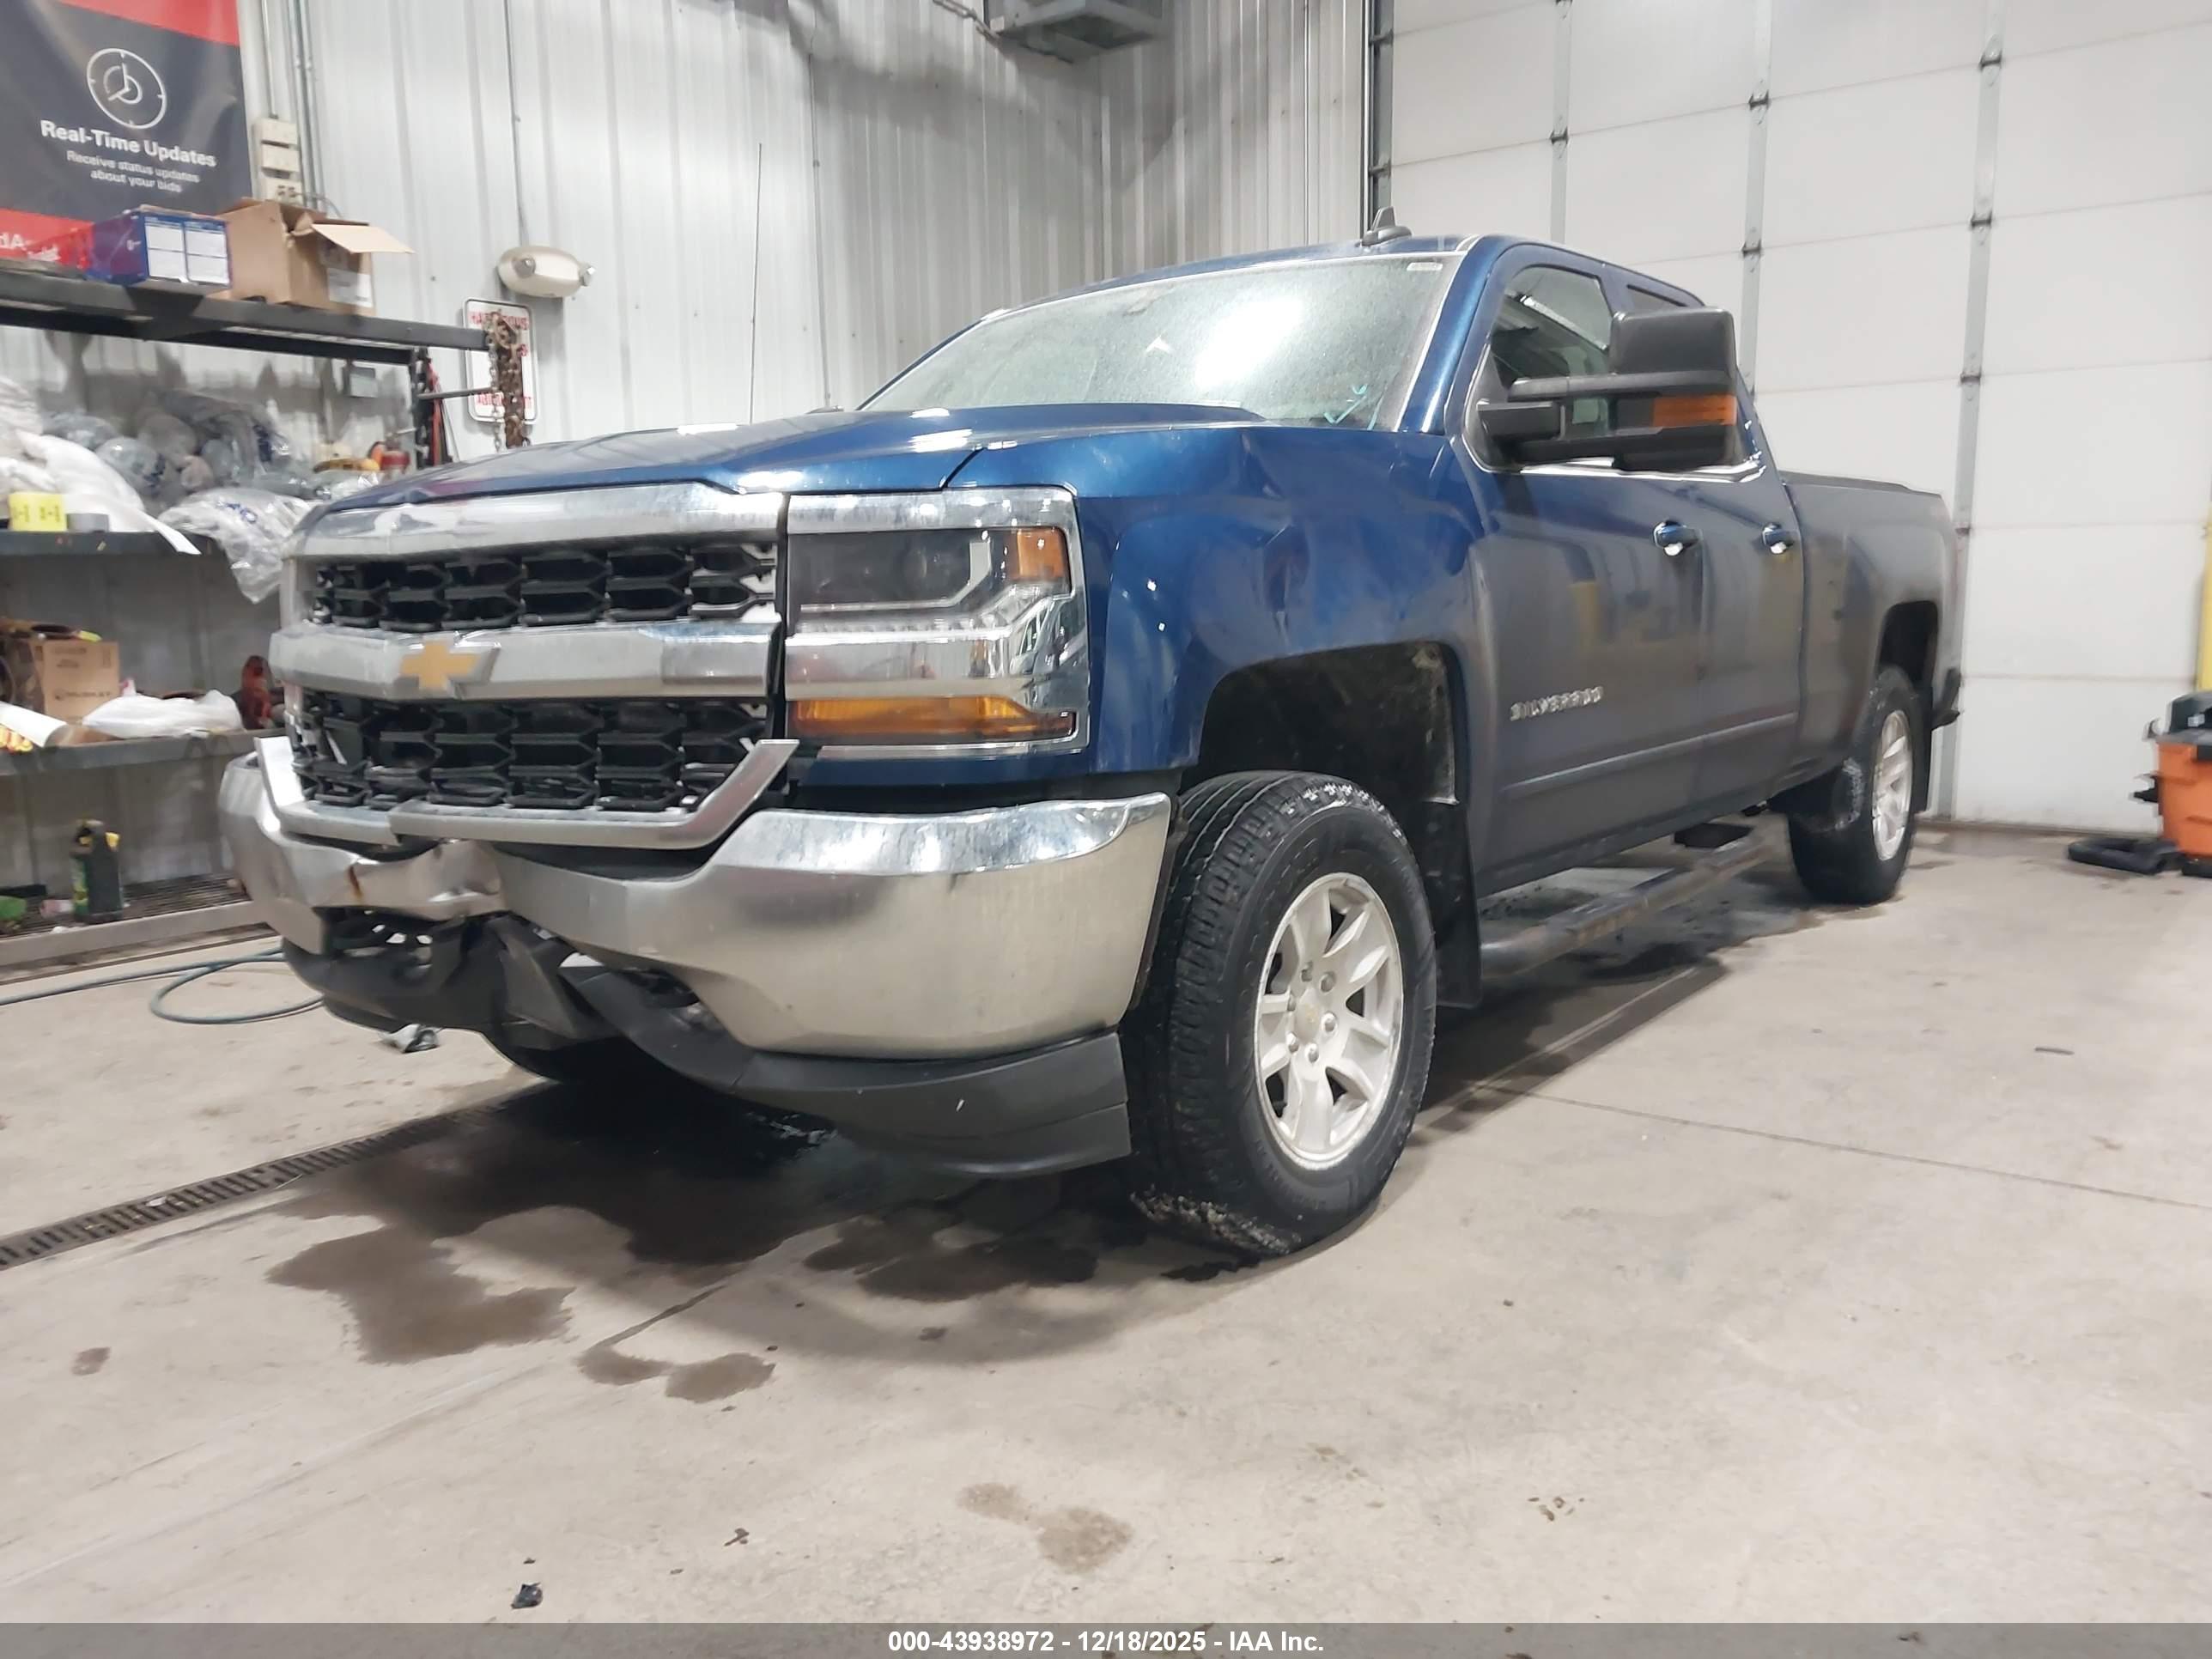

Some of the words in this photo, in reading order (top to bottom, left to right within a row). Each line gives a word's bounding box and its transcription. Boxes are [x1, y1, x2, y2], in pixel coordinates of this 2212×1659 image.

[40, 119, 140, 153] Real-Time
[143, 140, 216, 167] Updates
[66, 149, 116, 169] Receive
[118, 160, 154, 175] status
[155, 167, 201, 183] updates
[90, 169, 126, 184] about
[128, 175, 155, 187] your
[157, 179, 182, 193] bids
